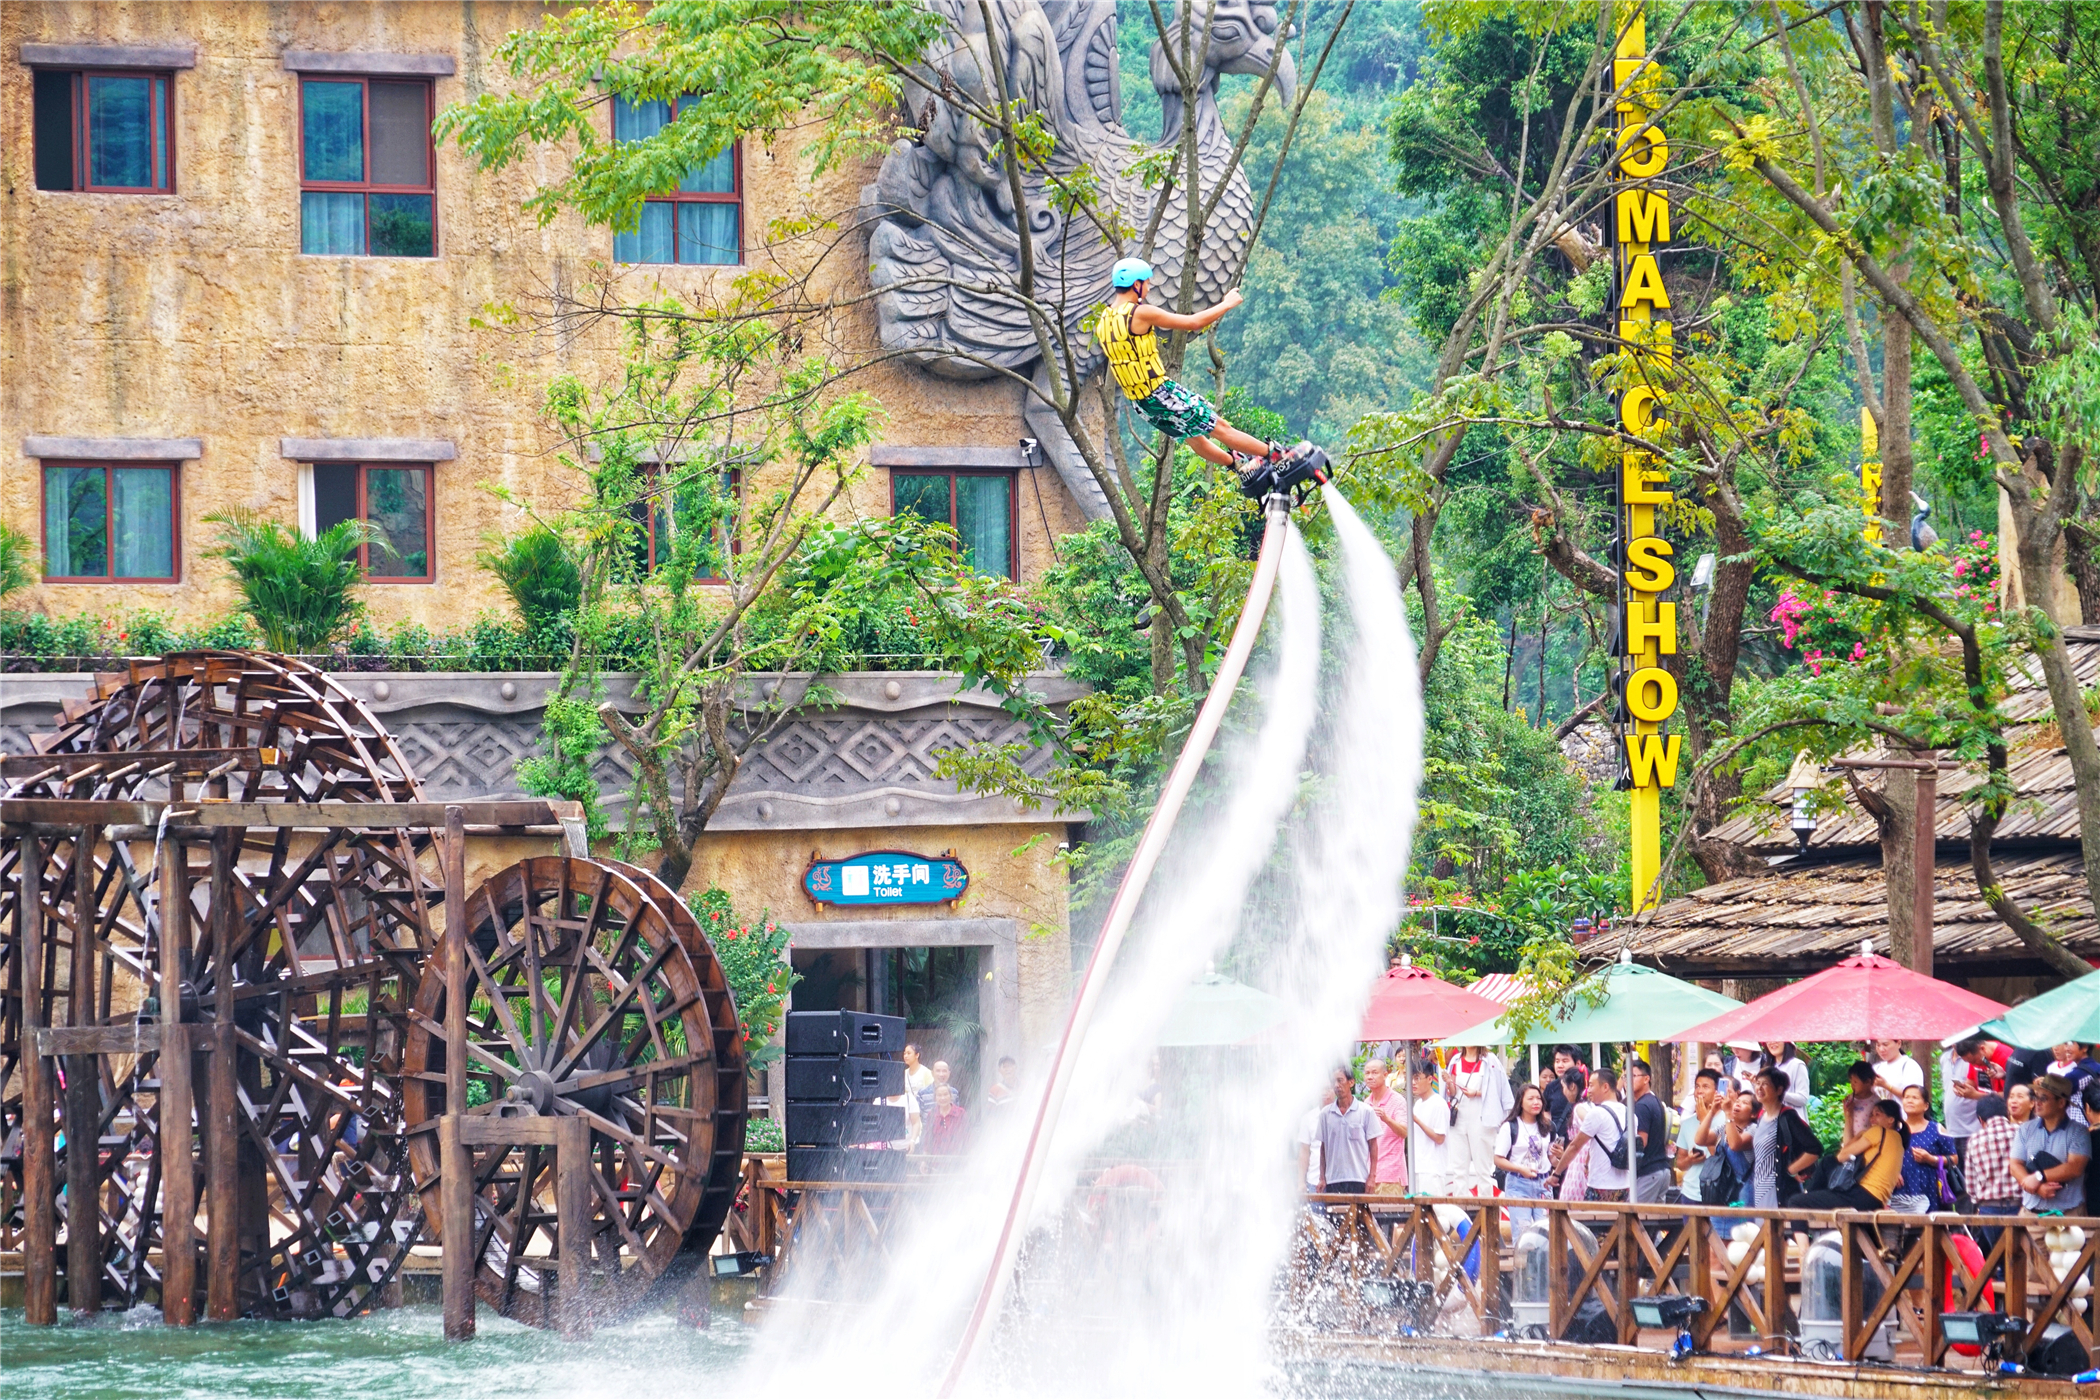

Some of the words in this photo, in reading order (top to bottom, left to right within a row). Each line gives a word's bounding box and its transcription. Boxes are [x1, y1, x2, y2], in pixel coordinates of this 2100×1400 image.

[1624, 536, 1683, 789] SHOW
[872, 863, 930, 885] 洗手间
[873, 887, 903, 897] Toilet
